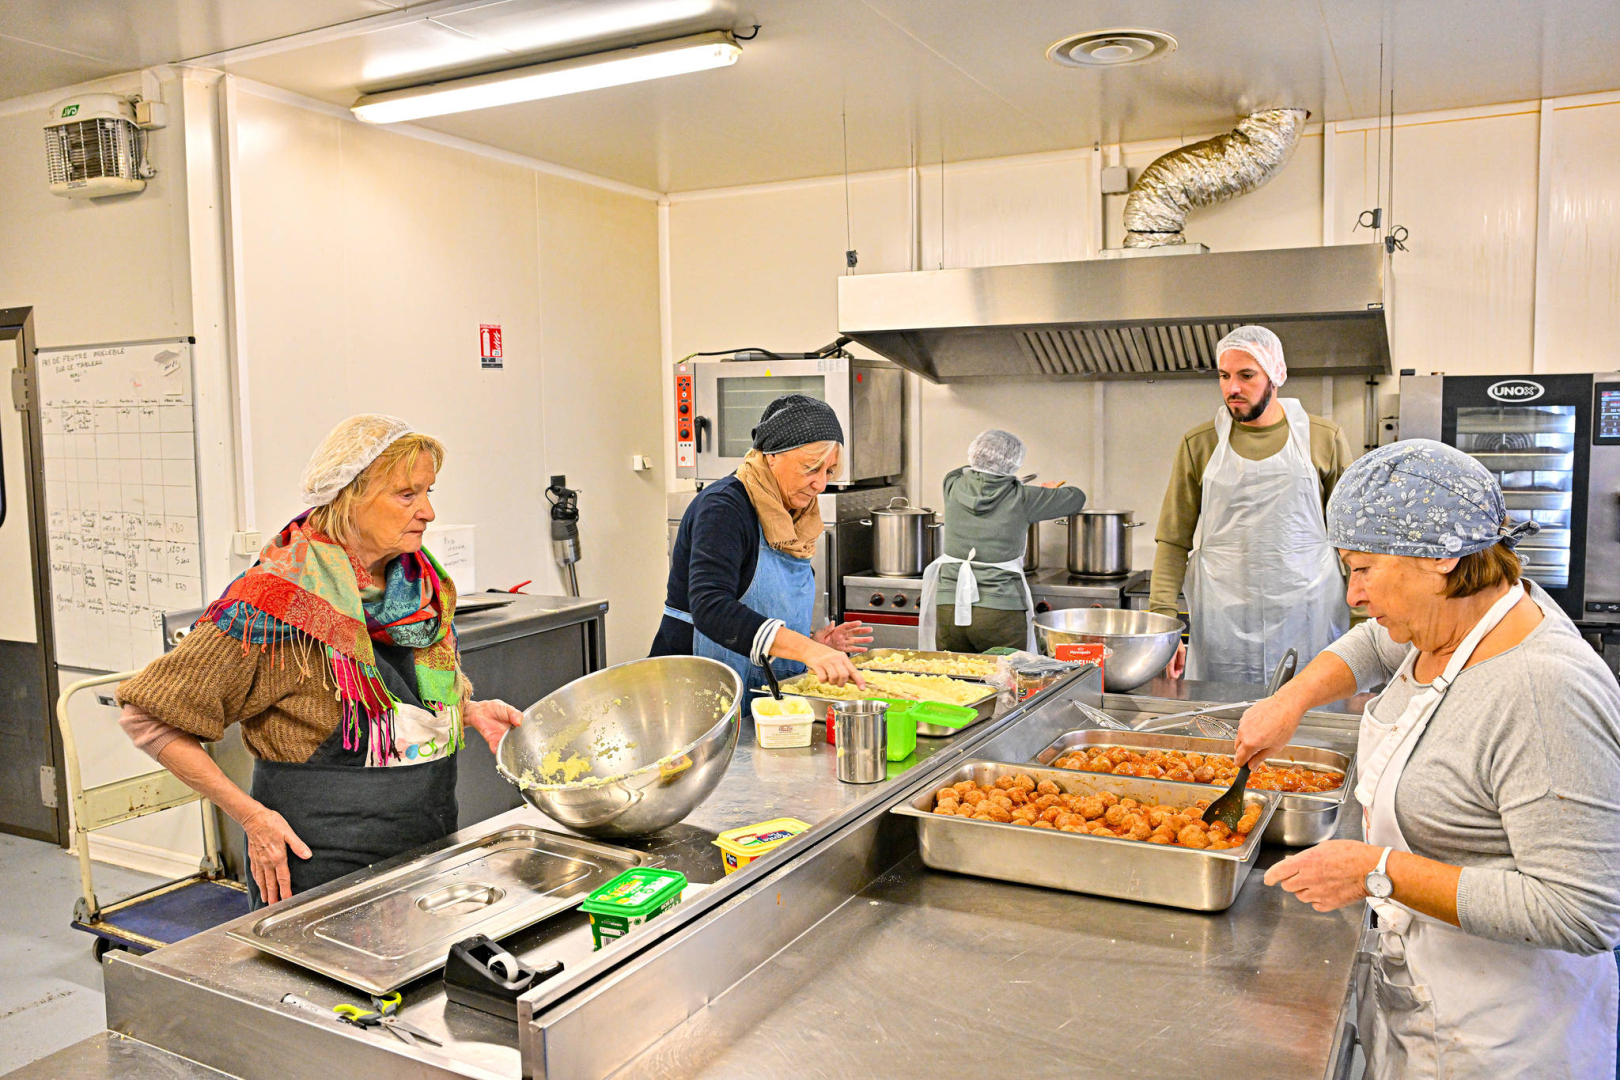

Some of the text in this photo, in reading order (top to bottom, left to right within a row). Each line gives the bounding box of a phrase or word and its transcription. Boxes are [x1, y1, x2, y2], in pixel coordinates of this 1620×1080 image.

[52, 356, 60, 365] DE
[62, 352, 88, 363] FEUTRE
[55, 366, 65, 374] SUR
[76, 360, 103, 368] TABLEAU
[1494, 386, 1535, 396] UNOX
